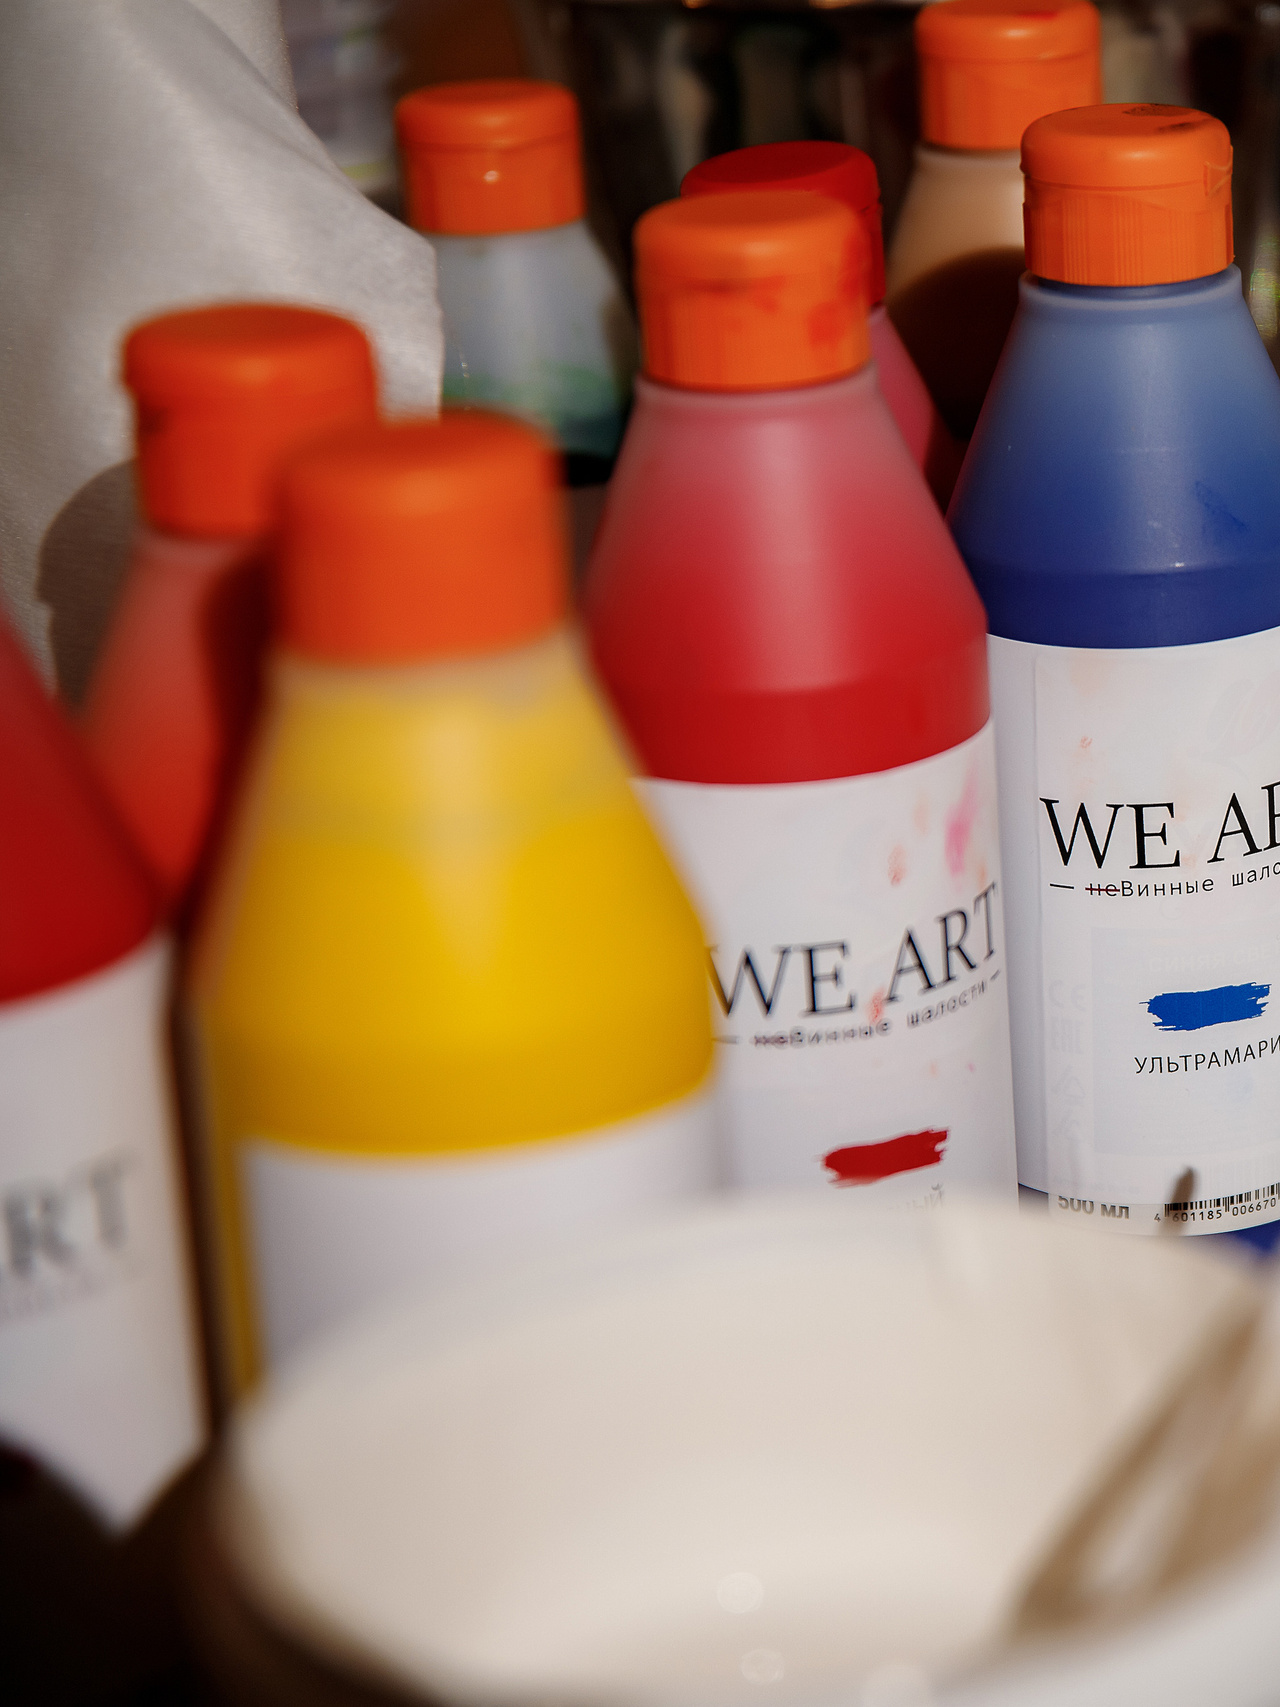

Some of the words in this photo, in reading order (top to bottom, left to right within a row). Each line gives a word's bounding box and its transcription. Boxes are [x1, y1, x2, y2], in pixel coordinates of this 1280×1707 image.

[1039, 797, 1181, 869] WE
[703, 938, 858, 1018] WE
[886, 881, 999, 1004] ART
[0, 1150, 142, 1281] RT
[1101, 1203, 1130, 1220] мл
